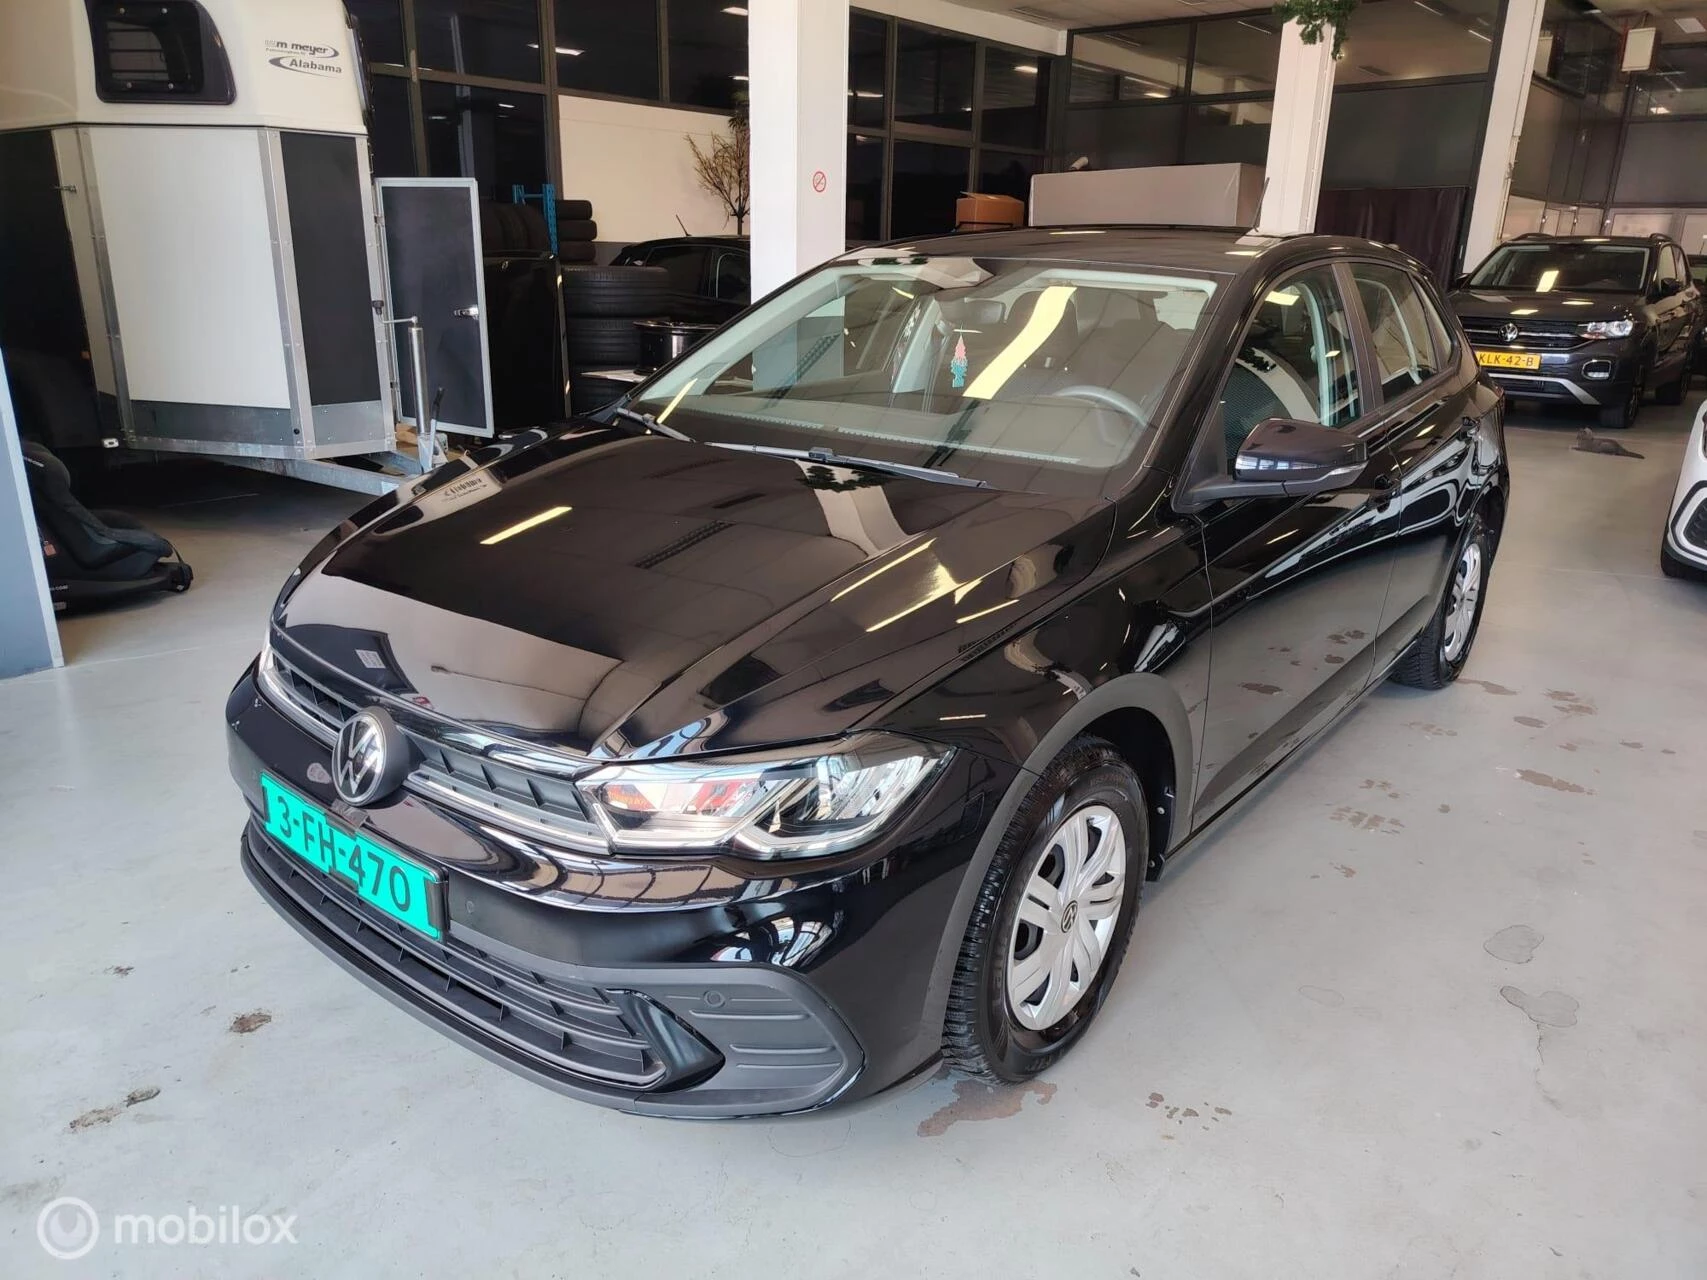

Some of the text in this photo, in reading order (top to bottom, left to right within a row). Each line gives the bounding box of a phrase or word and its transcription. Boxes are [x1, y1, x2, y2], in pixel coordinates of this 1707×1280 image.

[291, 42, 329, 56] meyer
[289, 58, 343, 74] Alabama
[1479, 353, 1534, 367] KLK-42-B
[277, 795, 411, 913] 3-FH-470
